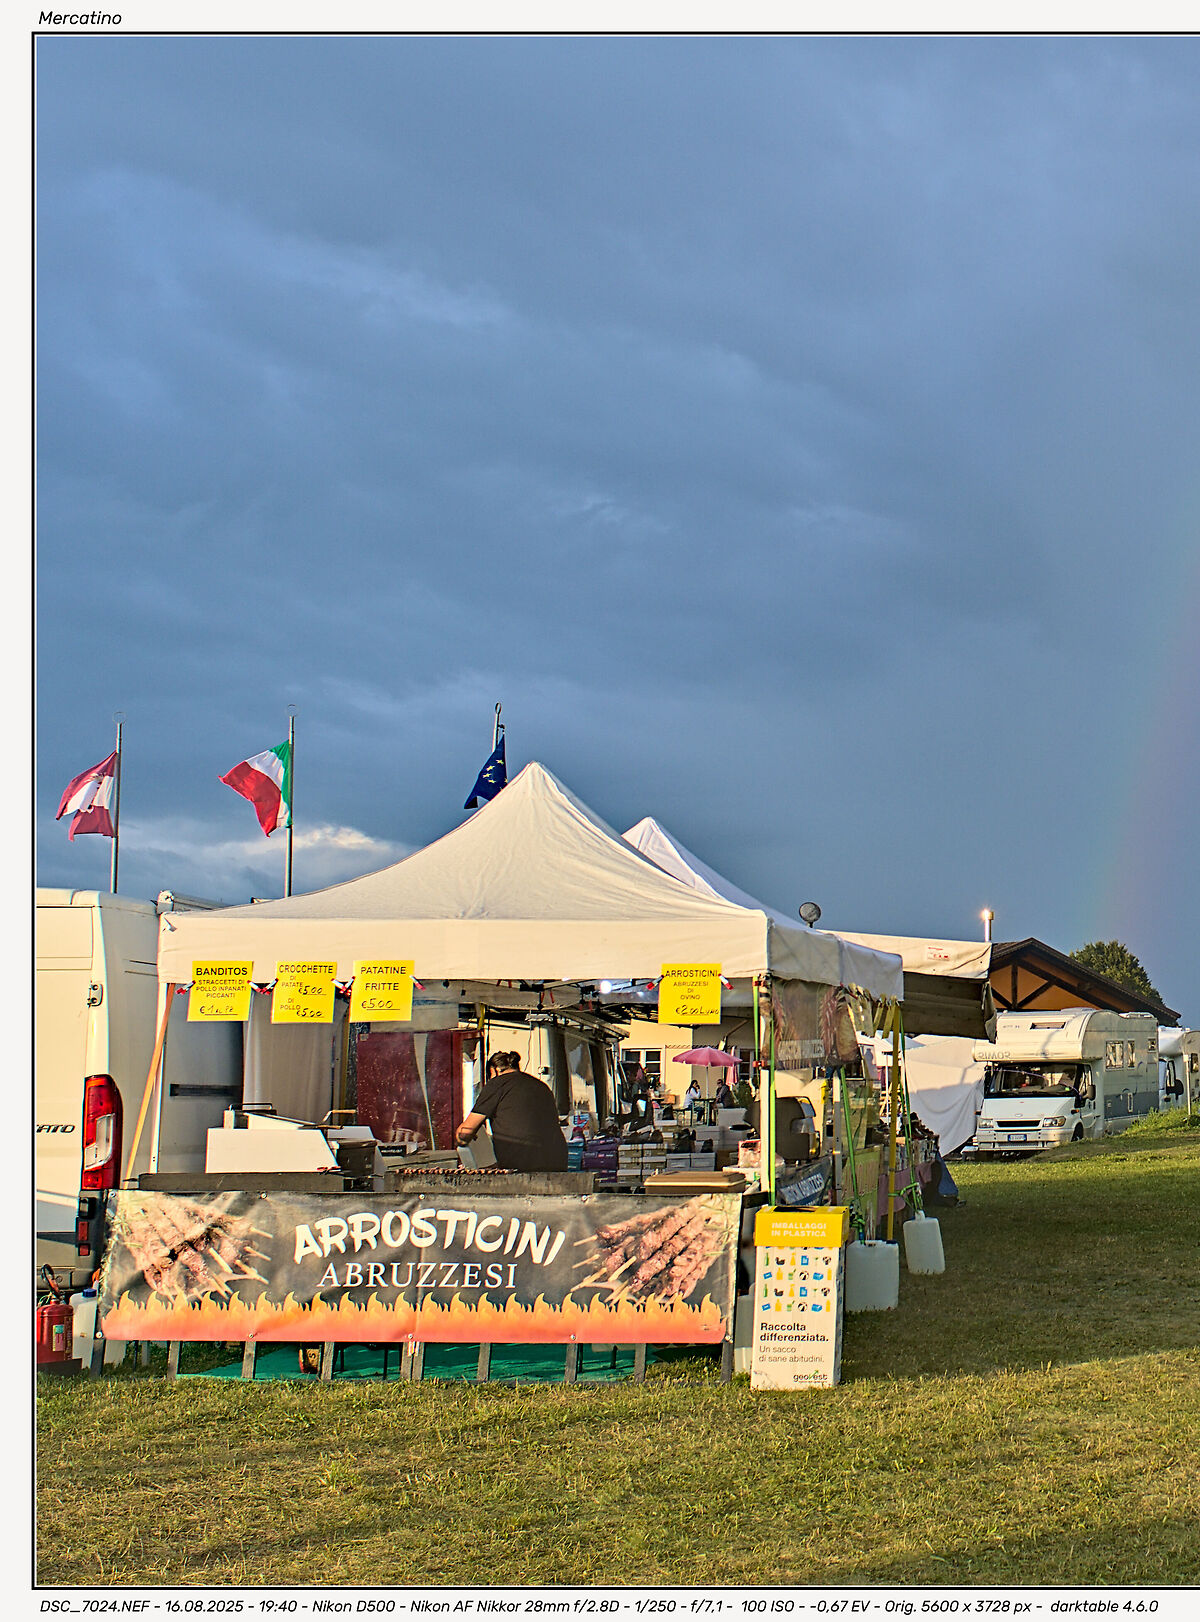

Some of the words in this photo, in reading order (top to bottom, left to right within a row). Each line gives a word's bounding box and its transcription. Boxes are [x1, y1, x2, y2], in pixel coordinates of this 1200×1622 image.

[195, 967, 248, 976] BANDITOS
[279, 964, 333, 973] CROCCHETTE
[360, 966, 407, 975] PATATINE
[664, 969, 718, 978] ARROSTICINI
[364, 982, 400, 991] FRITTE
[771, 1222, 827, 1230] IMBALLAGGI
[293, 1208, 566, 1267] ARROSTICINI
[316, 1262, 518, 1289] ABRUZZESI
[760, 1322, 807, 1331] Raccolta
[759, 1332, 829, 1342] differenziata.
[759, 1345, 771, 1353] Un
[758, 1354, 767, 1363] di
[788, 1354, 825, 1363] abitudini.
